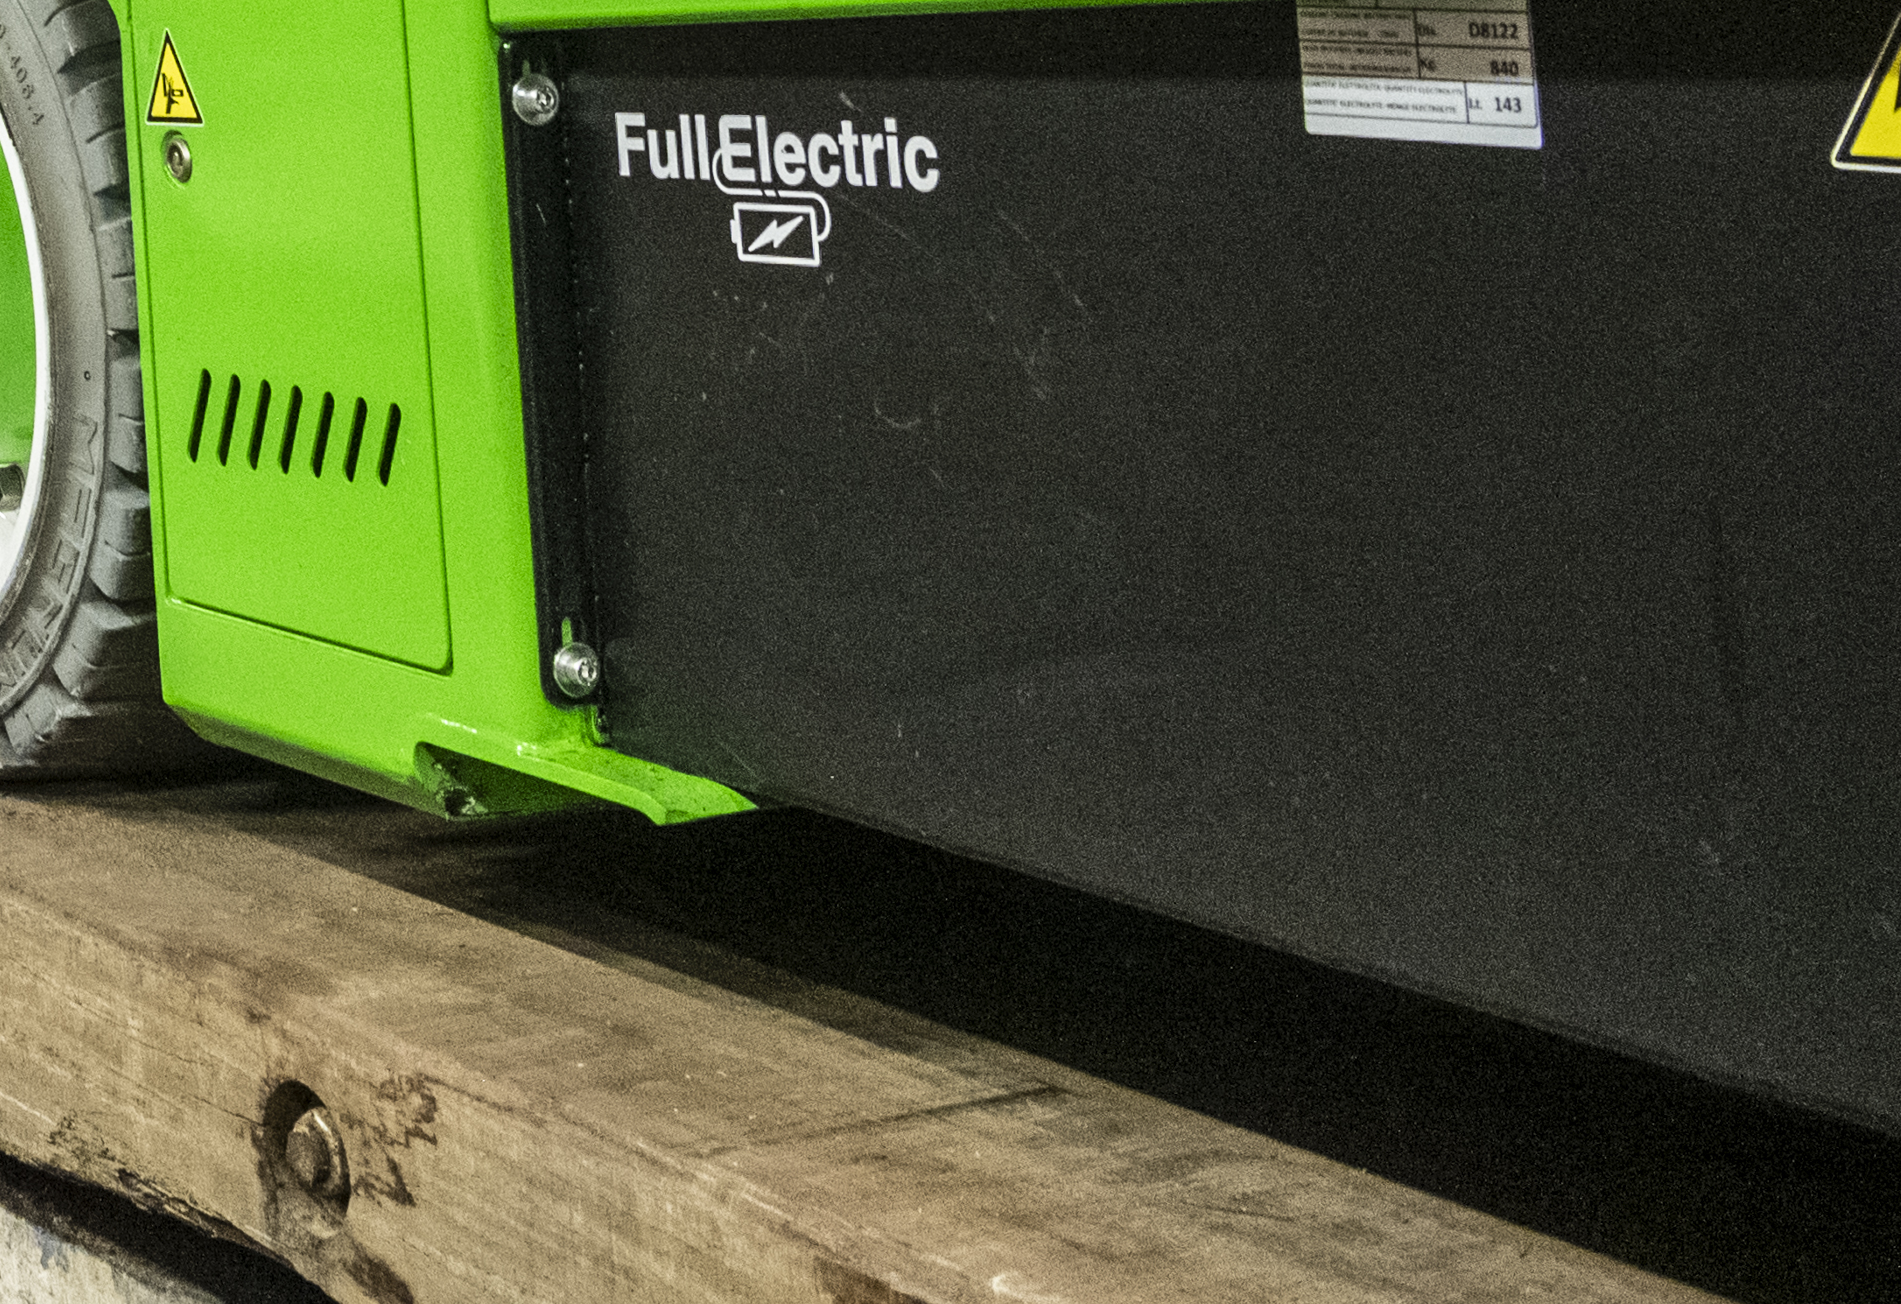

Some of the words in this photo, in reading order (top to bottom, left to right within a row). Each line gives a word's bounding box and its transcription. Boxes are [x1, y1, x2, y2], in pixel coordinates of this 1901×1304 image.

[1467, 22, 1519, 41] D8122
[1490, 60, 1519, 76] 840
[1494, 96, 1522, 113] 143
[614, 111, 941, 193] FullElectric
